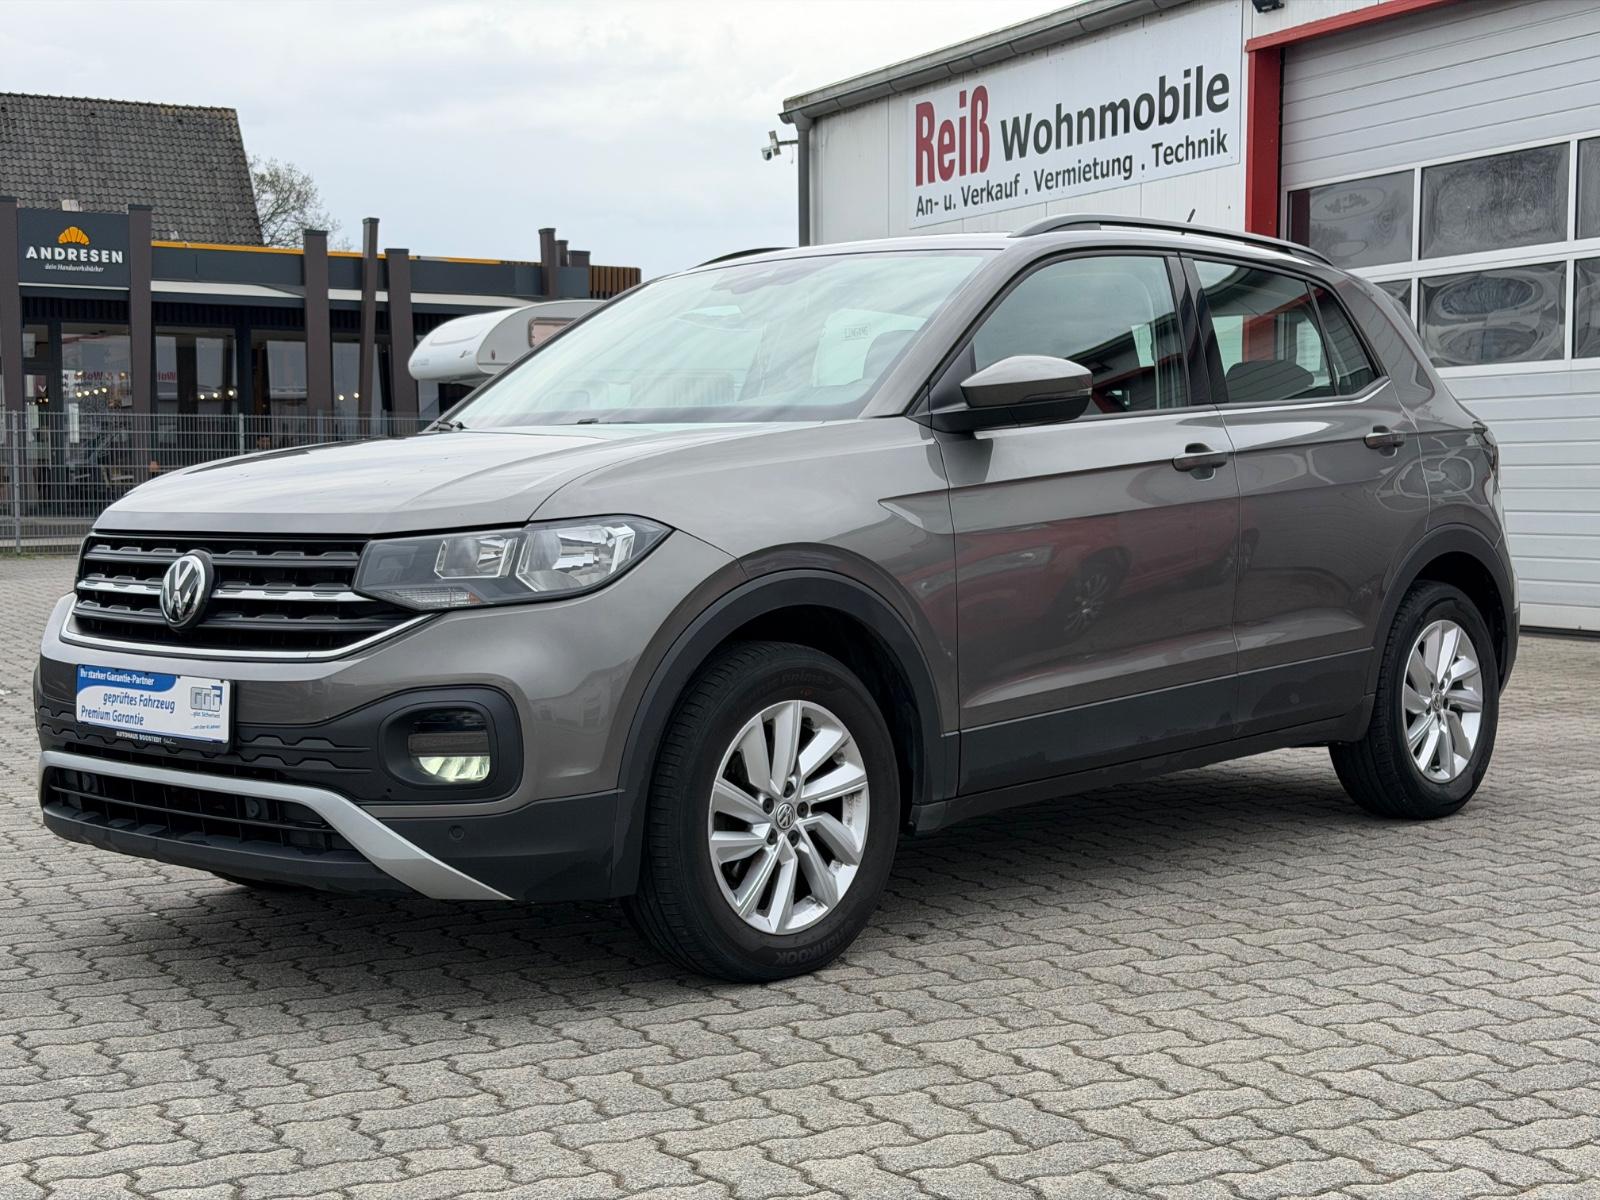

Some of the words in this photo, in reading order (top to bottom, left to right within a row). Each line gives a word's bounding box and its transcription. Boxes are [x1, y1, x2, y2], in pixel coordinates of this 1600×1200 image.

[915, 85, 990, 187] Reiß
[1000, 65, 1229, 161] Wohnmobile
[915, 195, 939, 217] An-
[944, 194, 957, 211] u.
[961, 173, 1020, 207] Verkauf
[1033, 154, 1133, 192] Vermietung
[1151, 128, 1228, 167] Technik
[26, 246, 123, 263] ANDRESEN
[80, 667, 88, 677] Ihr
[88, 669, 106, 680] starker
[106, 672, 154, 686] Garantie-Partner
[103, 691, 137, 706] geprüftes
[139, 694, 175, 713] Fahrzeug
[81, 705, 111, 720] Premium
[111, 710, 144, 726] Garantie
